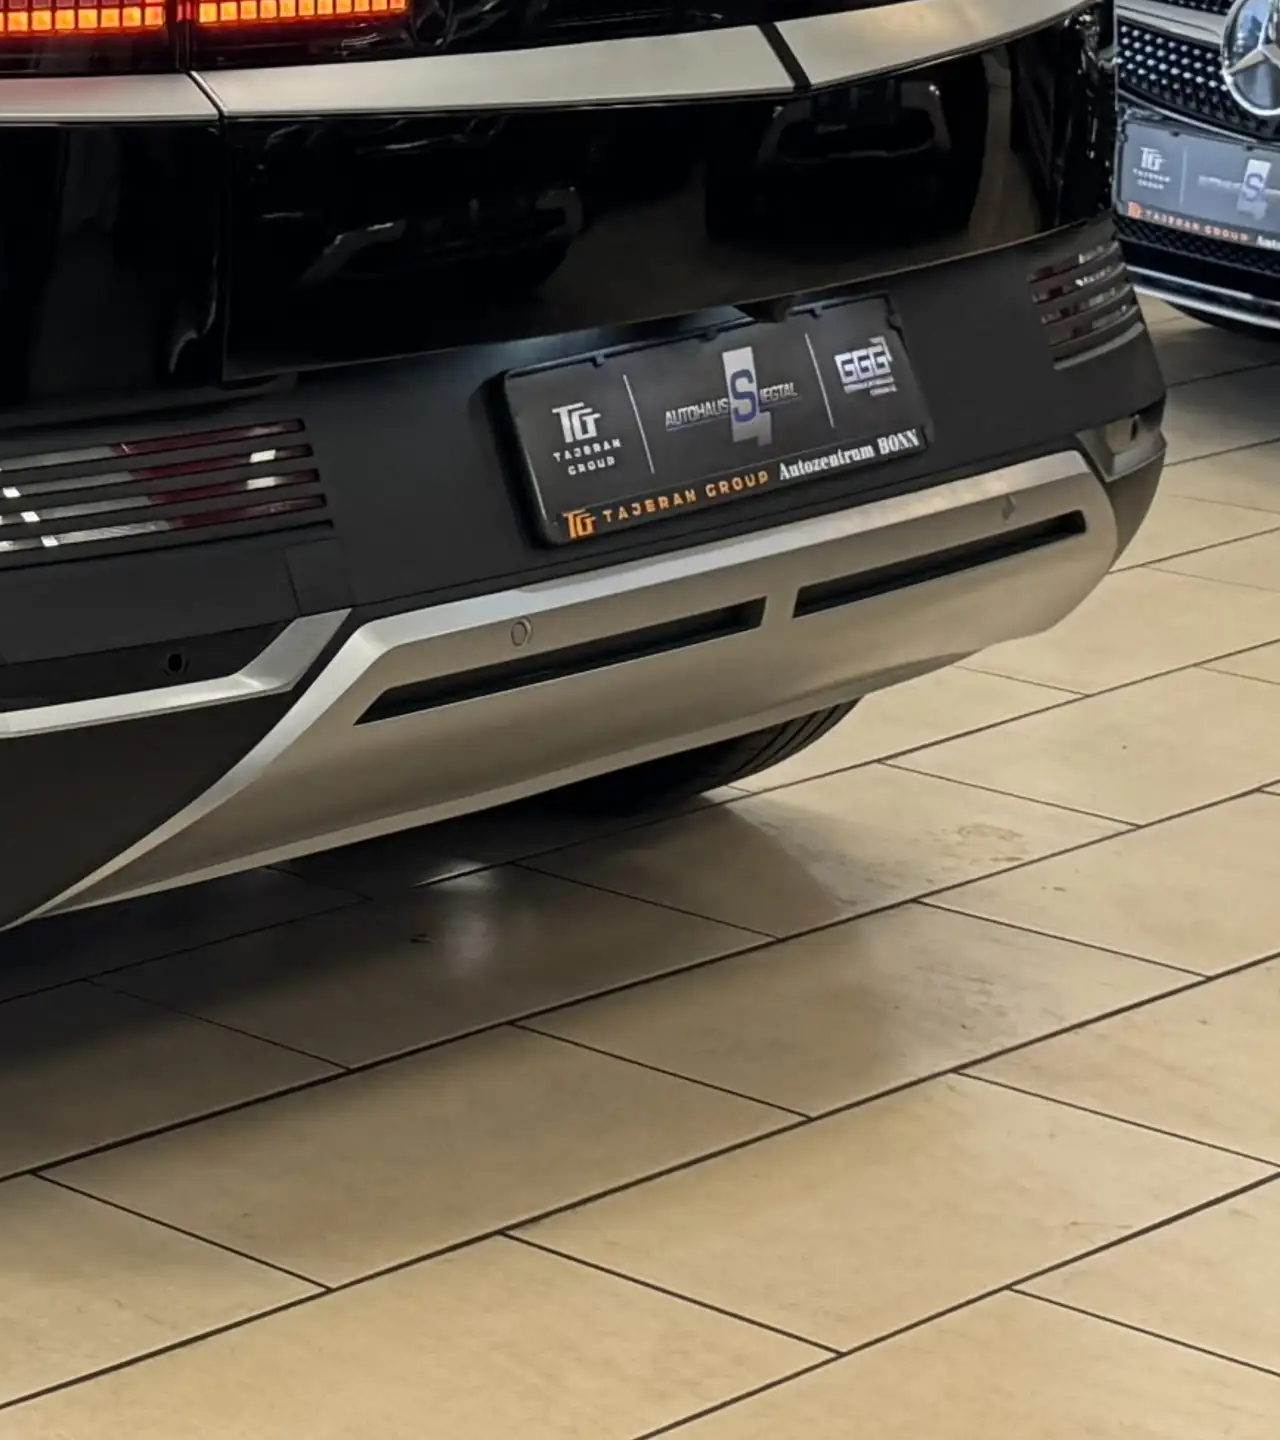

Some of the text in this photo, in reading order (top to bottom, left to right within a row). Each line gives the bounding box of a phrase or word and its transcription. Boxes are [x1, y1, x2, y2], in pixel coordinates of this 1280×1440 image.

[665, 397, 730, 428] AUTOHAUS
[552, 438, 622, 463] TAJERAN
[567, 456, 616, 476] GROUP
[602, 488, 697, 524] TAJERAN
[705, 470, 769, 498] GROUP
[779, 443, 876, 481] Autozentrum
[876, 427, 921, 456] BONN
